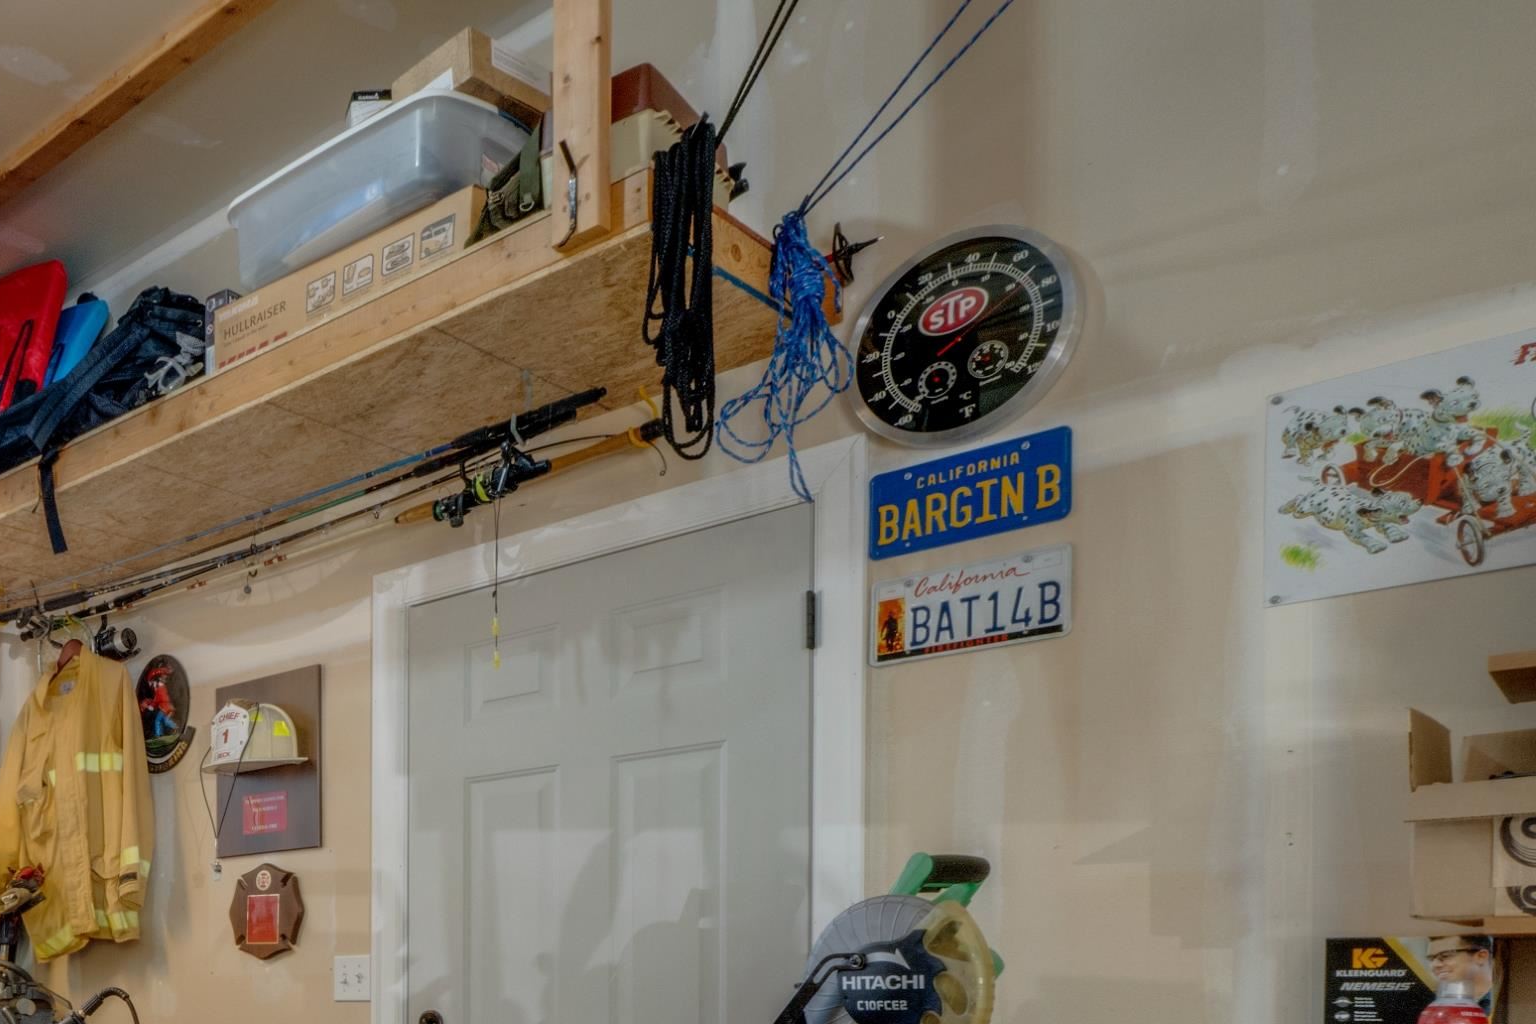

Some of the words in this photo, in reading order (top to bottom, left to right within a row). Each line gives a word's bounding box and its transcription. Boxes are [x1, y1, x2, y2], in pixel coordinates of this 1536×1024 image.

[224, 300, 286, 340] HULLRAISER
[929, 293, 977, 330] STP
[916, 451, 1020, 489] CALIFORNIA
[877, 471, 1025, 546] BARGIN
[1035, 464, 1061, 510] B
[914, 565, 1032, 598] California
[910, 580, 1061, 647] BAT14B
[218, 711, 241, 723] CHIEF
[222, 728, 229, 744] 1
[842, 974, 925, 990] HITACHI
[1335, 969, 1407, 977] KLEENGUARD
[1340, 982, 1411, 991] NEMESIS
